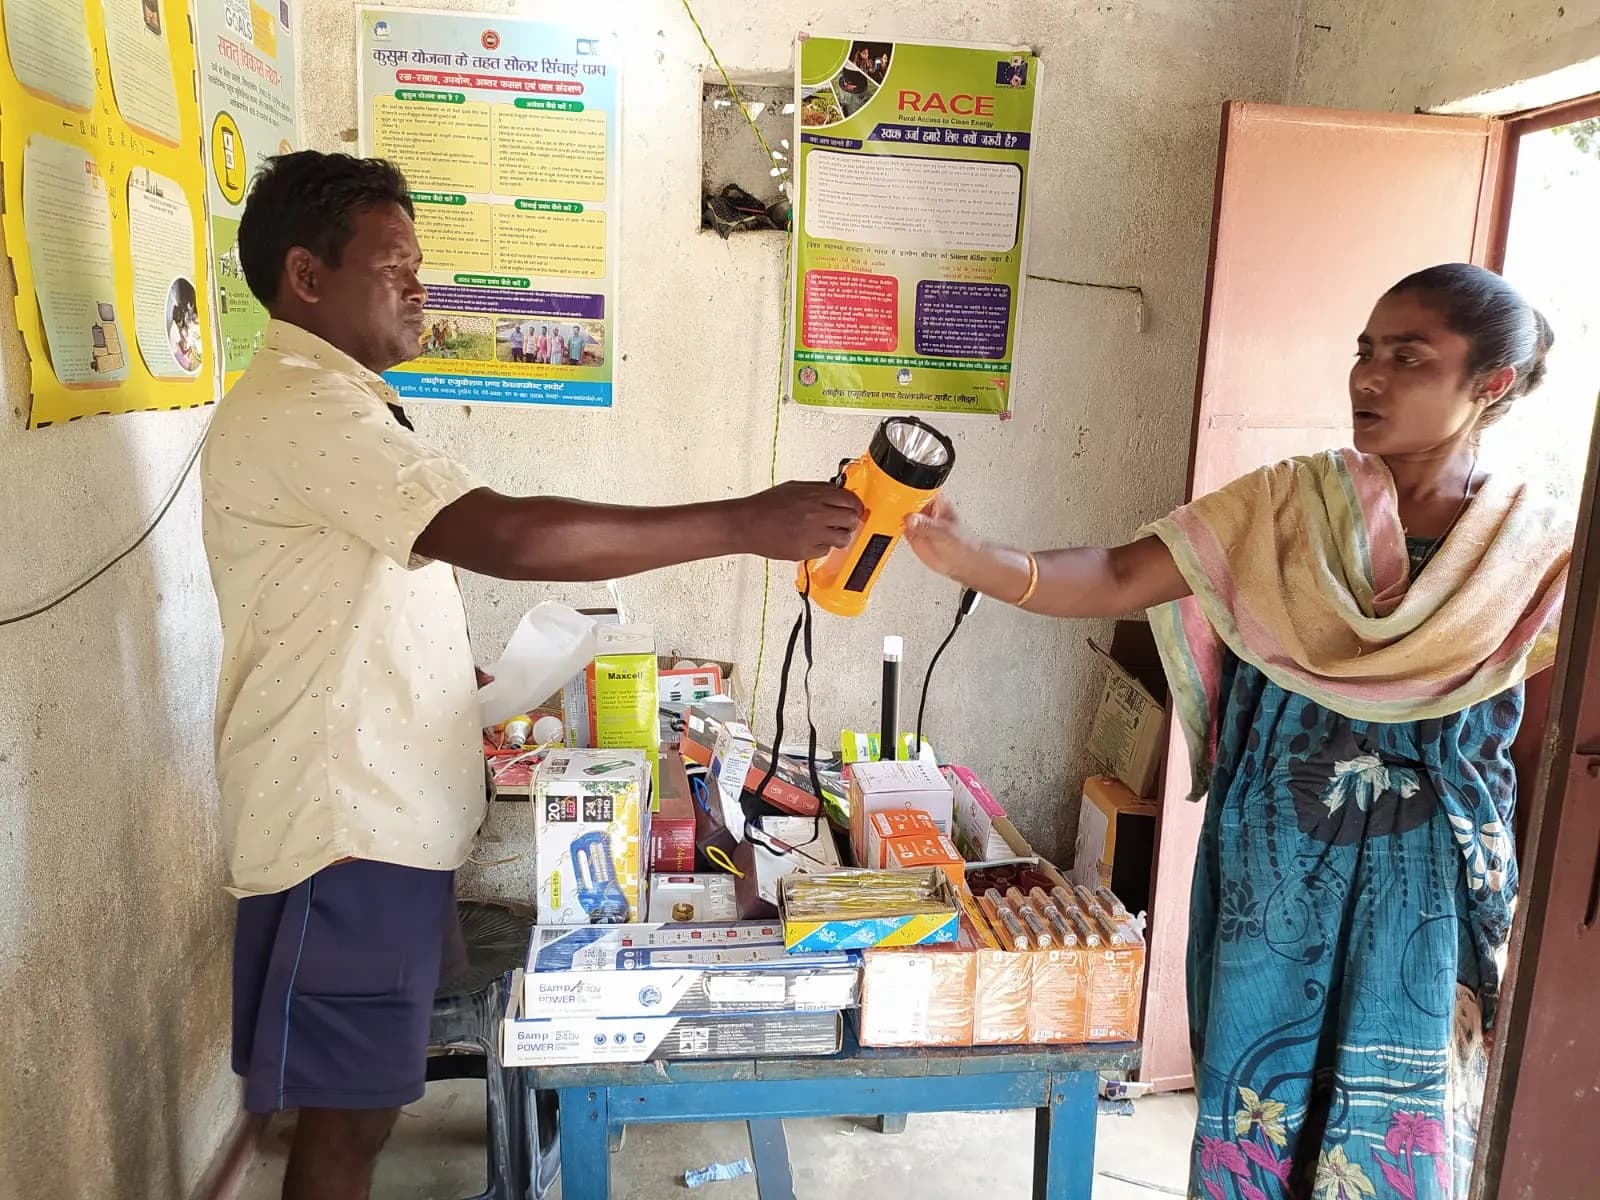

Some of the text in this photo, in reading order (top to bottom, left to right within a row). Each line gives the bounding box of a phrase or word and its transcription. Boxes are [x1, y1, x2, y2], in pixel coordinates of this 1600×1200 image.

[226, 7, 252, 41] GOALS
[372, 49, 408, 67] कुसुम
[411, 49, 452, 66] योजना
[454, 52, 469, 66] के
[472, 56, 500, 70] तहत
[504, 55, 538, 72] सोलर
[541, 58, 578, 77] सिंचाई
[898, 90, 995, 117] RACE
[898, 114, 916, 122] Rural
[917, 116, 941, 124] Access
[950, 118, 970, 126] Clean
[970, 120, 994, 128] Energy
[921, 129, 940, 143] हमारे
[943, 129, 959, 143] लिए
[961, 130, 977, 145] क्यों
[1003, 133, 1017, 147] है?
[949, 252, 969, 261] Silent
[970, 253, 987, 262] Killer
[607, 671, 643, 680] Maxcell
[548, 802, 561, 821] 20
[538, 994, 576, 1004] POWER
[517, 1043, 554, 1052] POWER
